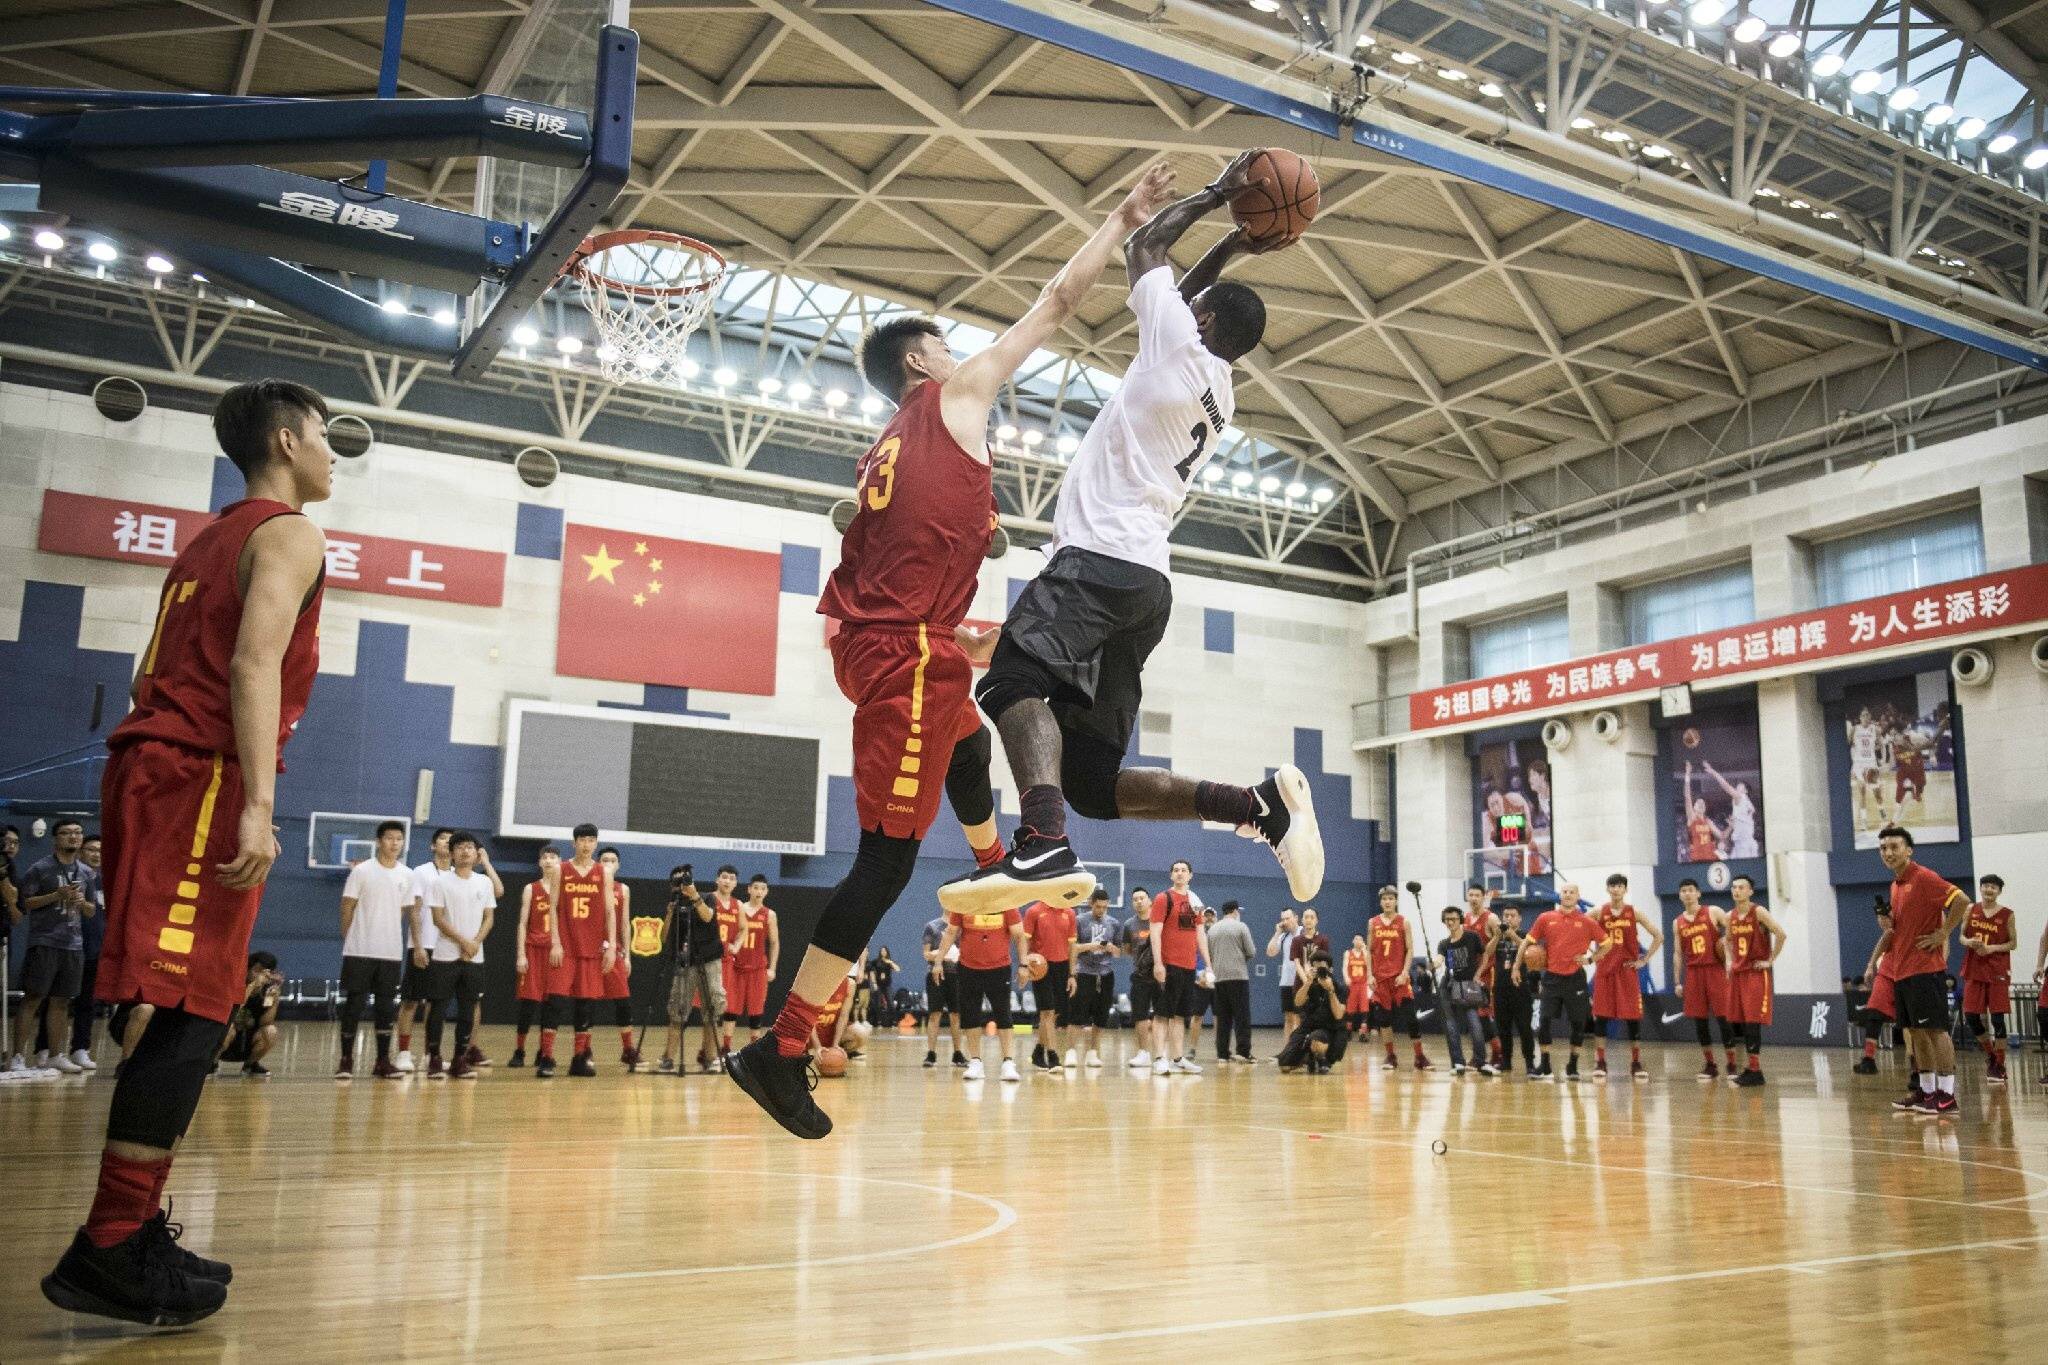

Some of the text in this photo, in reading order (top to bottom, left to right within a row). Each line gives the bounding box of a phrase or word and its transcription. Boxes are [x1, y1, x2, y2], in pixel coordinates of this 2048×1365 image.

[493, 106, 580, 139] 金陵
[261, 191, 412, 240] 金陵
[1199, 387, 1226, 434] IRVING
[1173, 421, 1208, 482] 2
[1433, 583, 2010, 721] 为祖国争光 为民族争气 为奥运增辉 为人生添彩
[886, 802, 914, 814] CHINA
[1714, 867, 1723, 884] 3
[564, 882, 599, 893] CHINA
[572, 897, 591, 918] 15
[1604, 919, 1631, 929] CHINA
[1971, 919, 1998, 933] CHINA
[1375, 929, 1400, 938] CHINA
[1381, 940, 1392, 957] 7
[1737, 936, 1748, 956] 9
[150, 960, 188, 976] CHINA
